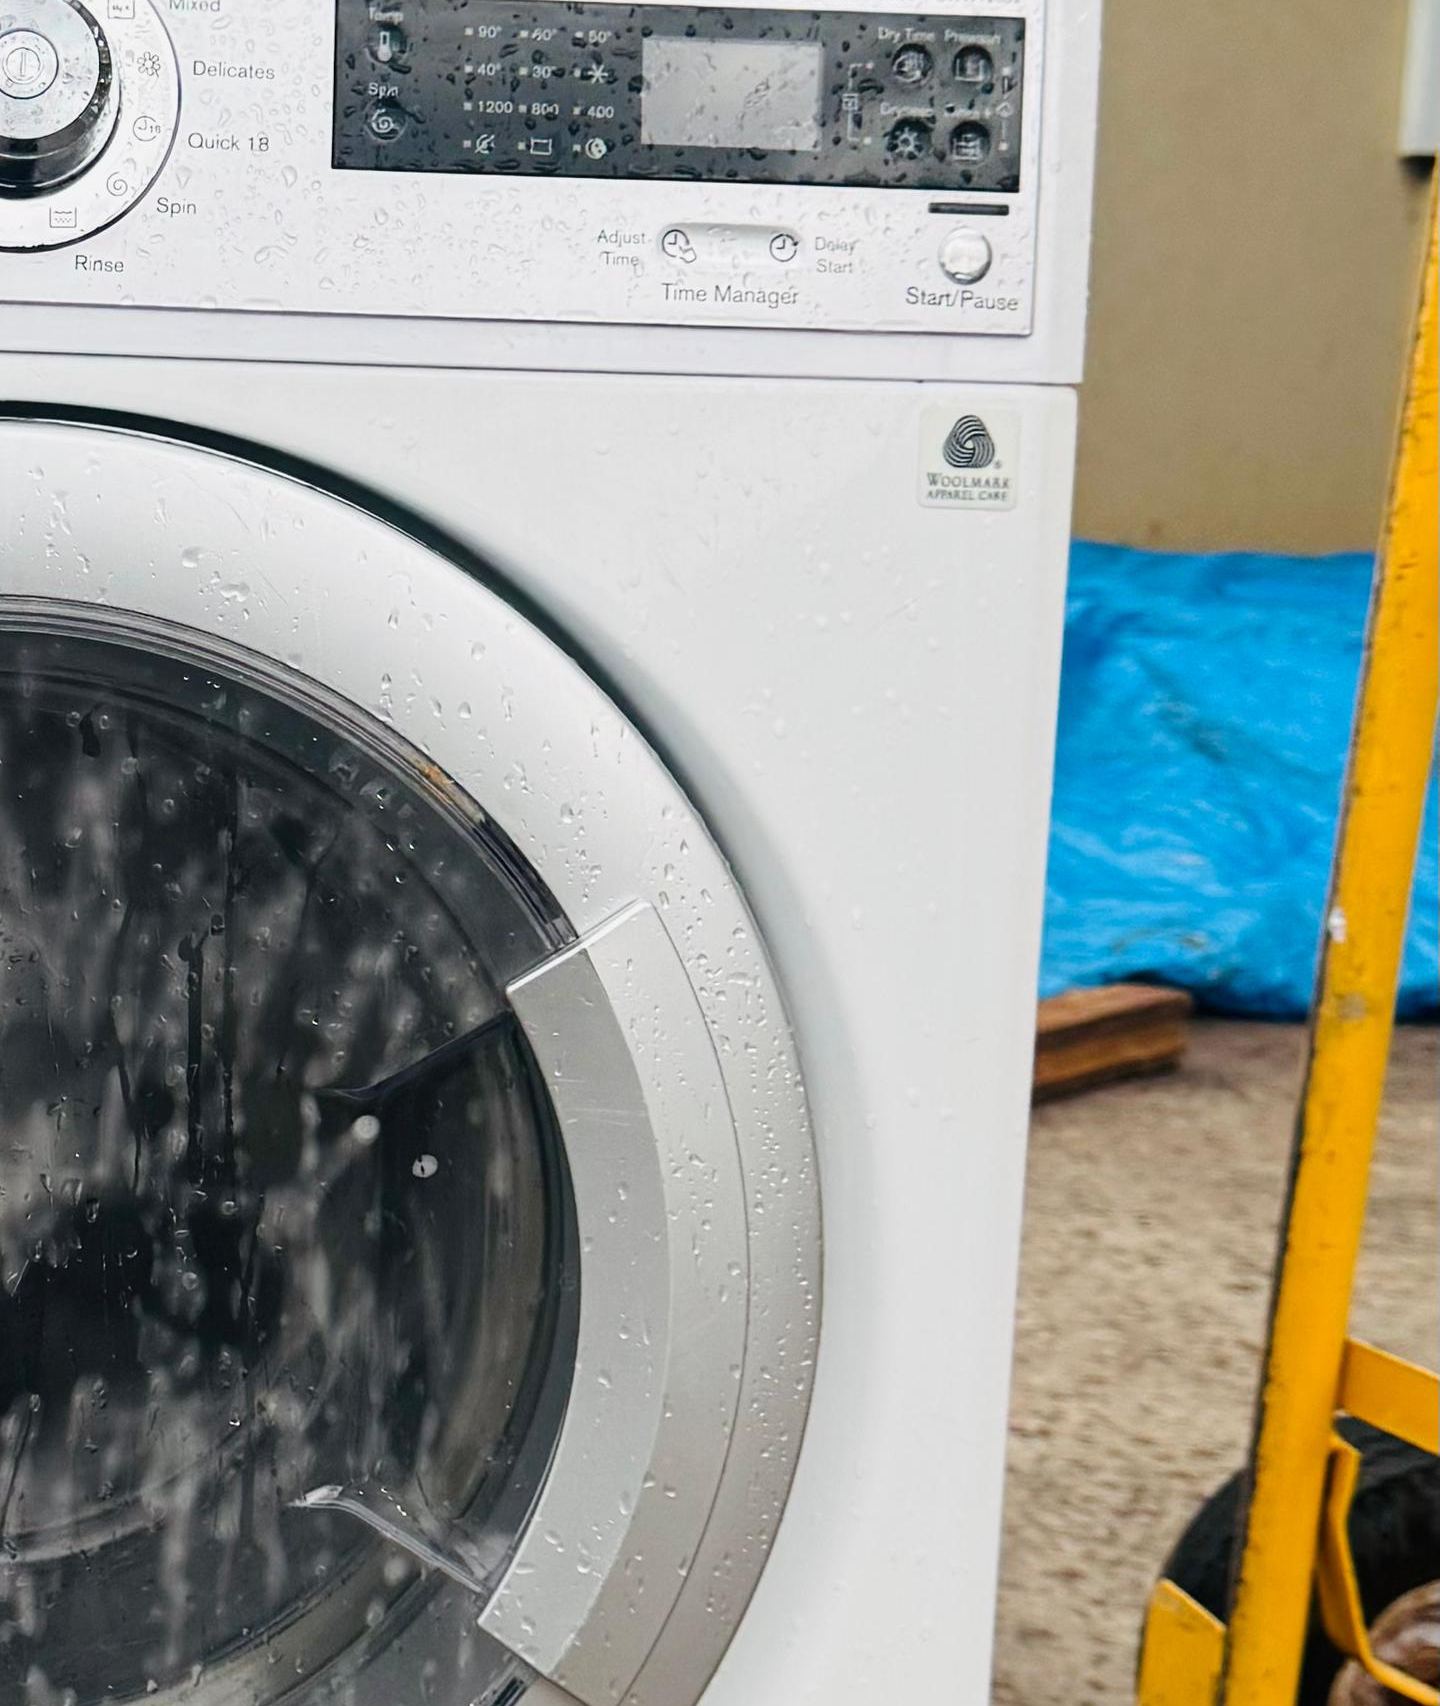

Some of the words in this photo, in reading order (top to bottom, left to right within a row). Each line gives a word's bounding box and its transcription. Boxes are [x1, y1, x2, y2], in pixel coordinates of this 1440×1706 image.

[193, 60, 276, 80] Delicates
[477, 100, 513, 114] 1200
[586, 105, 615, 120] 400
[187, 132, 240, 151] Quick
[156, 197, 197, 217] Spin
[597, 230, 647, 248] Adjust
[75, 254, 125, 273] Rinse
[601, 252, 640, 267] Time
[816, 260, 853, 274] Start
[662, 283, 708, 302] Time
[714, 285, 800, 310] Manager
[906, 286, 1019, 312] Start/Pause
